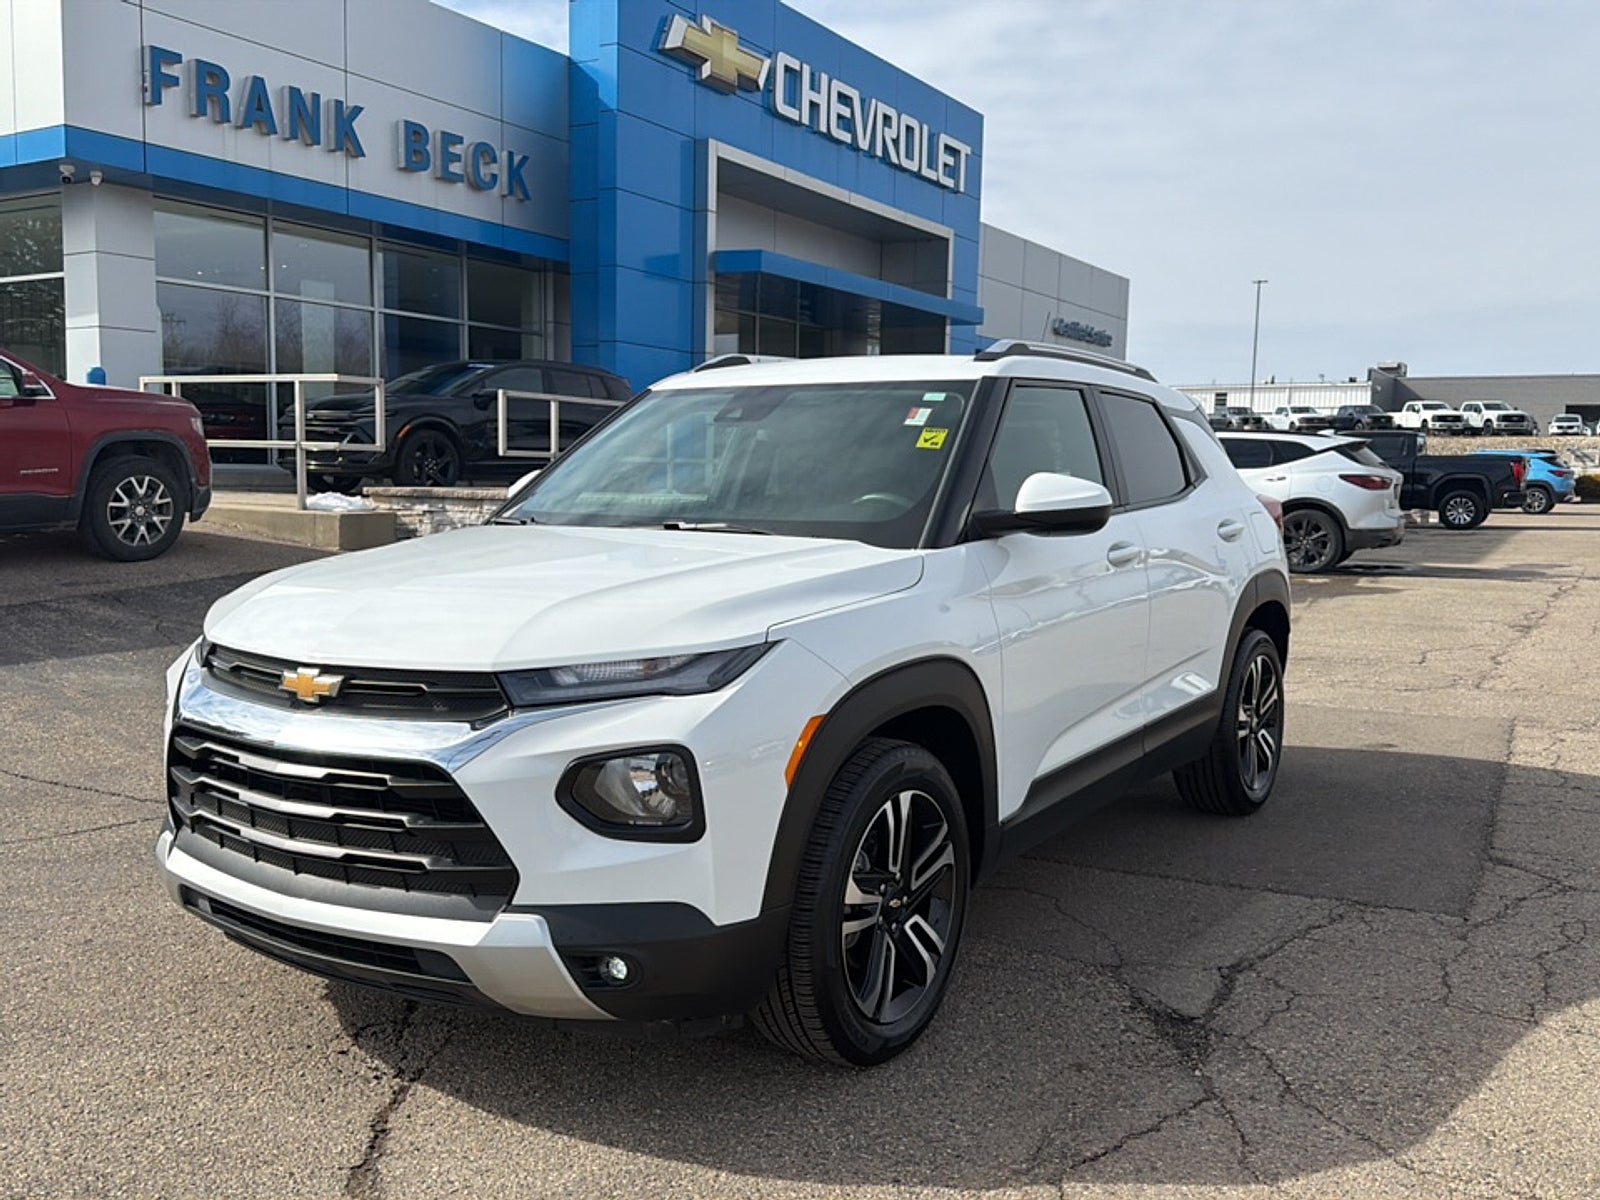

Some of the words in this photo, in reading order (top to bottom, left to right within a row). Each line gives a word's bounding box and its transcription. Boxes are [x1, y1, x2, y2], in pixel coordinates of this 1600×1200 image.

[143, 45, 366, 158] FRANK
[398, 119, 532, 201] BECK
[774, 51, 971, 193] CHEVROLET
